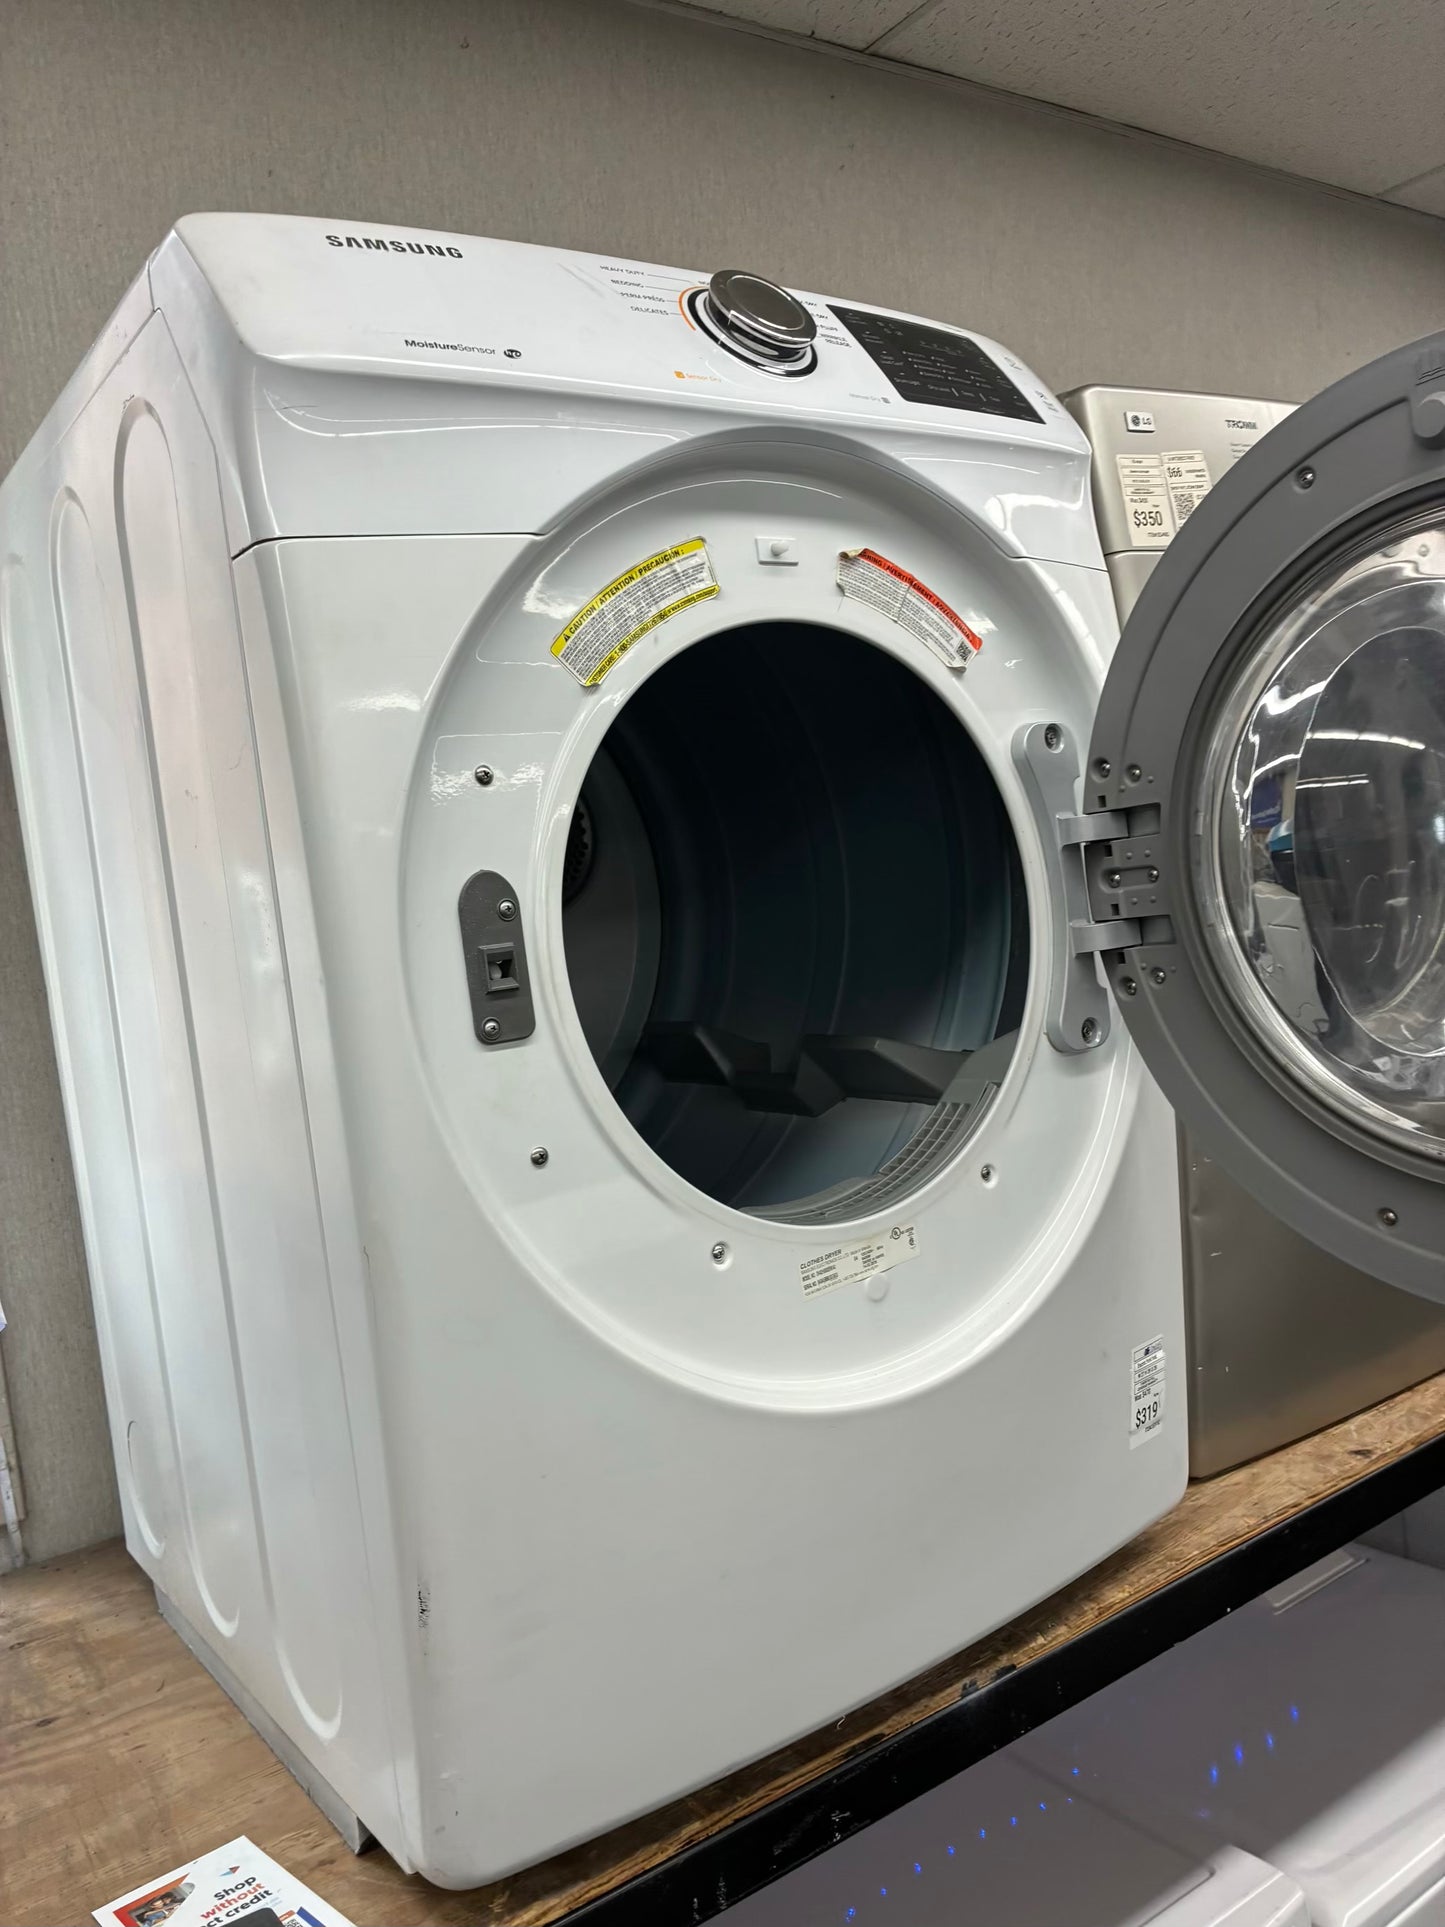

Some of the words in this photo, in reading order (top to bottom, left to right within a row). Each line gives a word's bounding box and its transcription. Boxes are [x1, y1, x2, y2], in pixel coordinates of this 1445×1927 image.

[325, 235, 463, 259] SAMSUNG
[1142, 417, 1153, 426] LG
[1133, 508, 1163, 528] $350
[569, 604, 597, 635] CAUTION
[599, 574, 635, 606] ATTENTION
[800, 1256, 824, 1270] CLOTHES
[824, 1249, 842, 1260] DRYER
[1135, 1401, 1158, 1429] $319
[200, 1883, 266, 1919] without
[213, 1876, 257, 1901] Shop
[225, 1890, 274, 1917] credit
